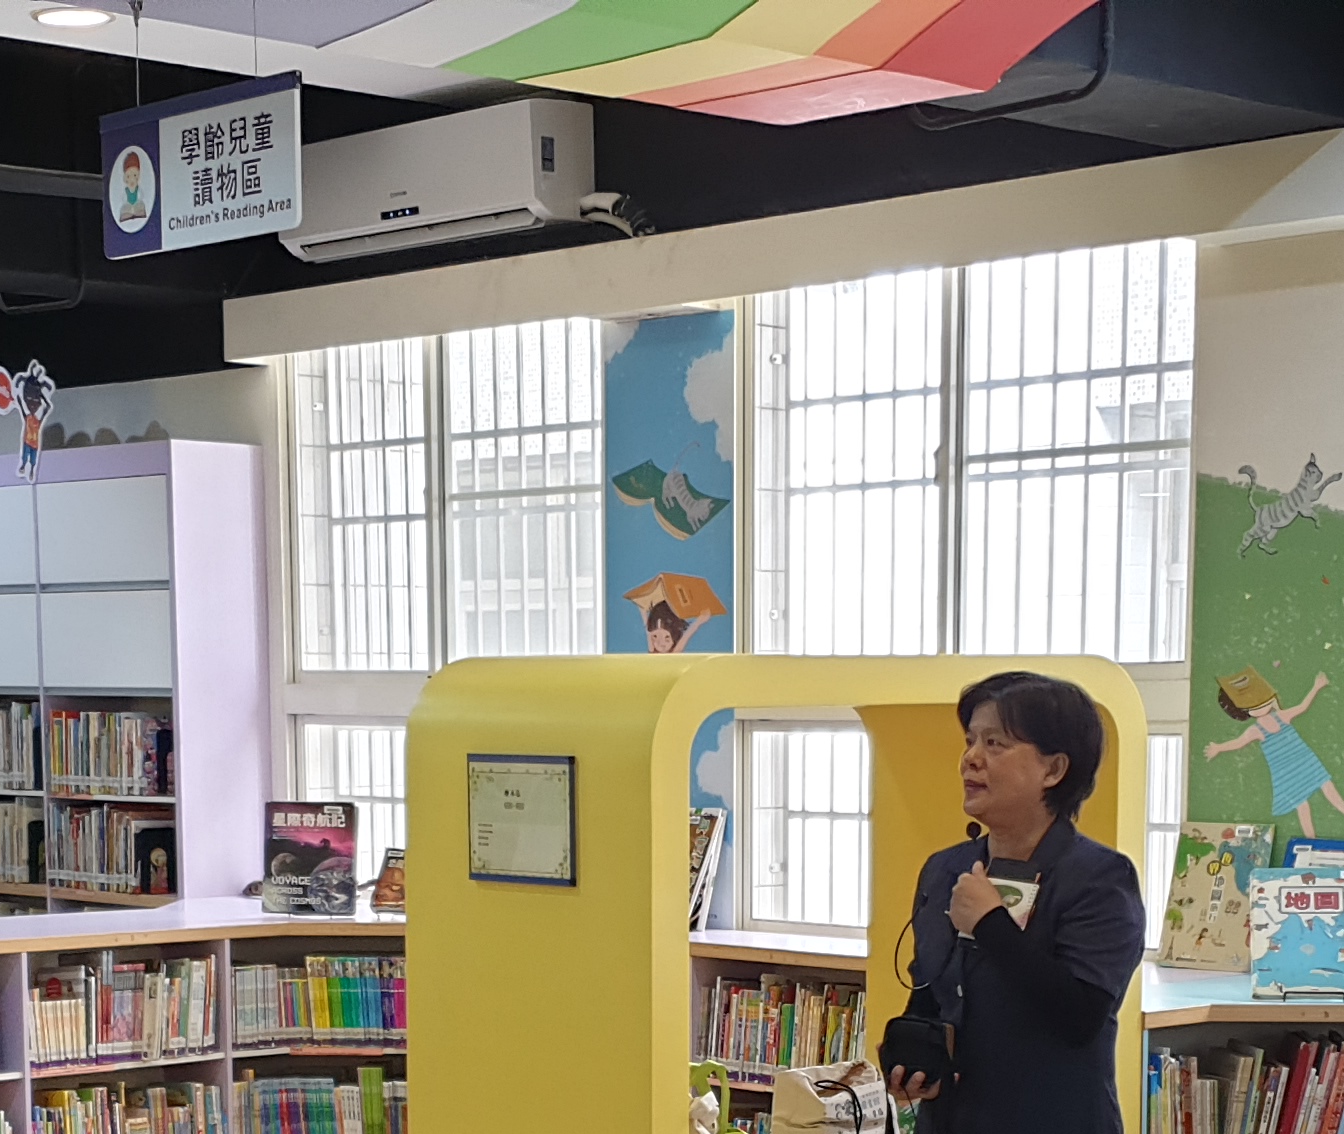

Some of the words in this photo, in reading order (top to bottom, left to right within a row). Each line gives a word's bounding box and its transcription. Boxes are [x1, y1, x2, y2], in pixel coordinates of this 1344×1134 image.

[181, 111, 274, 165] 學齡兒童
[192, 158, 263, 207] 讀物區
[169, 210, 220, 231] Children's
[222, 203, 265, 221] Reading
[267, 198, 292, 213] Area
[271, 876, 312, 886] VOYAGE
